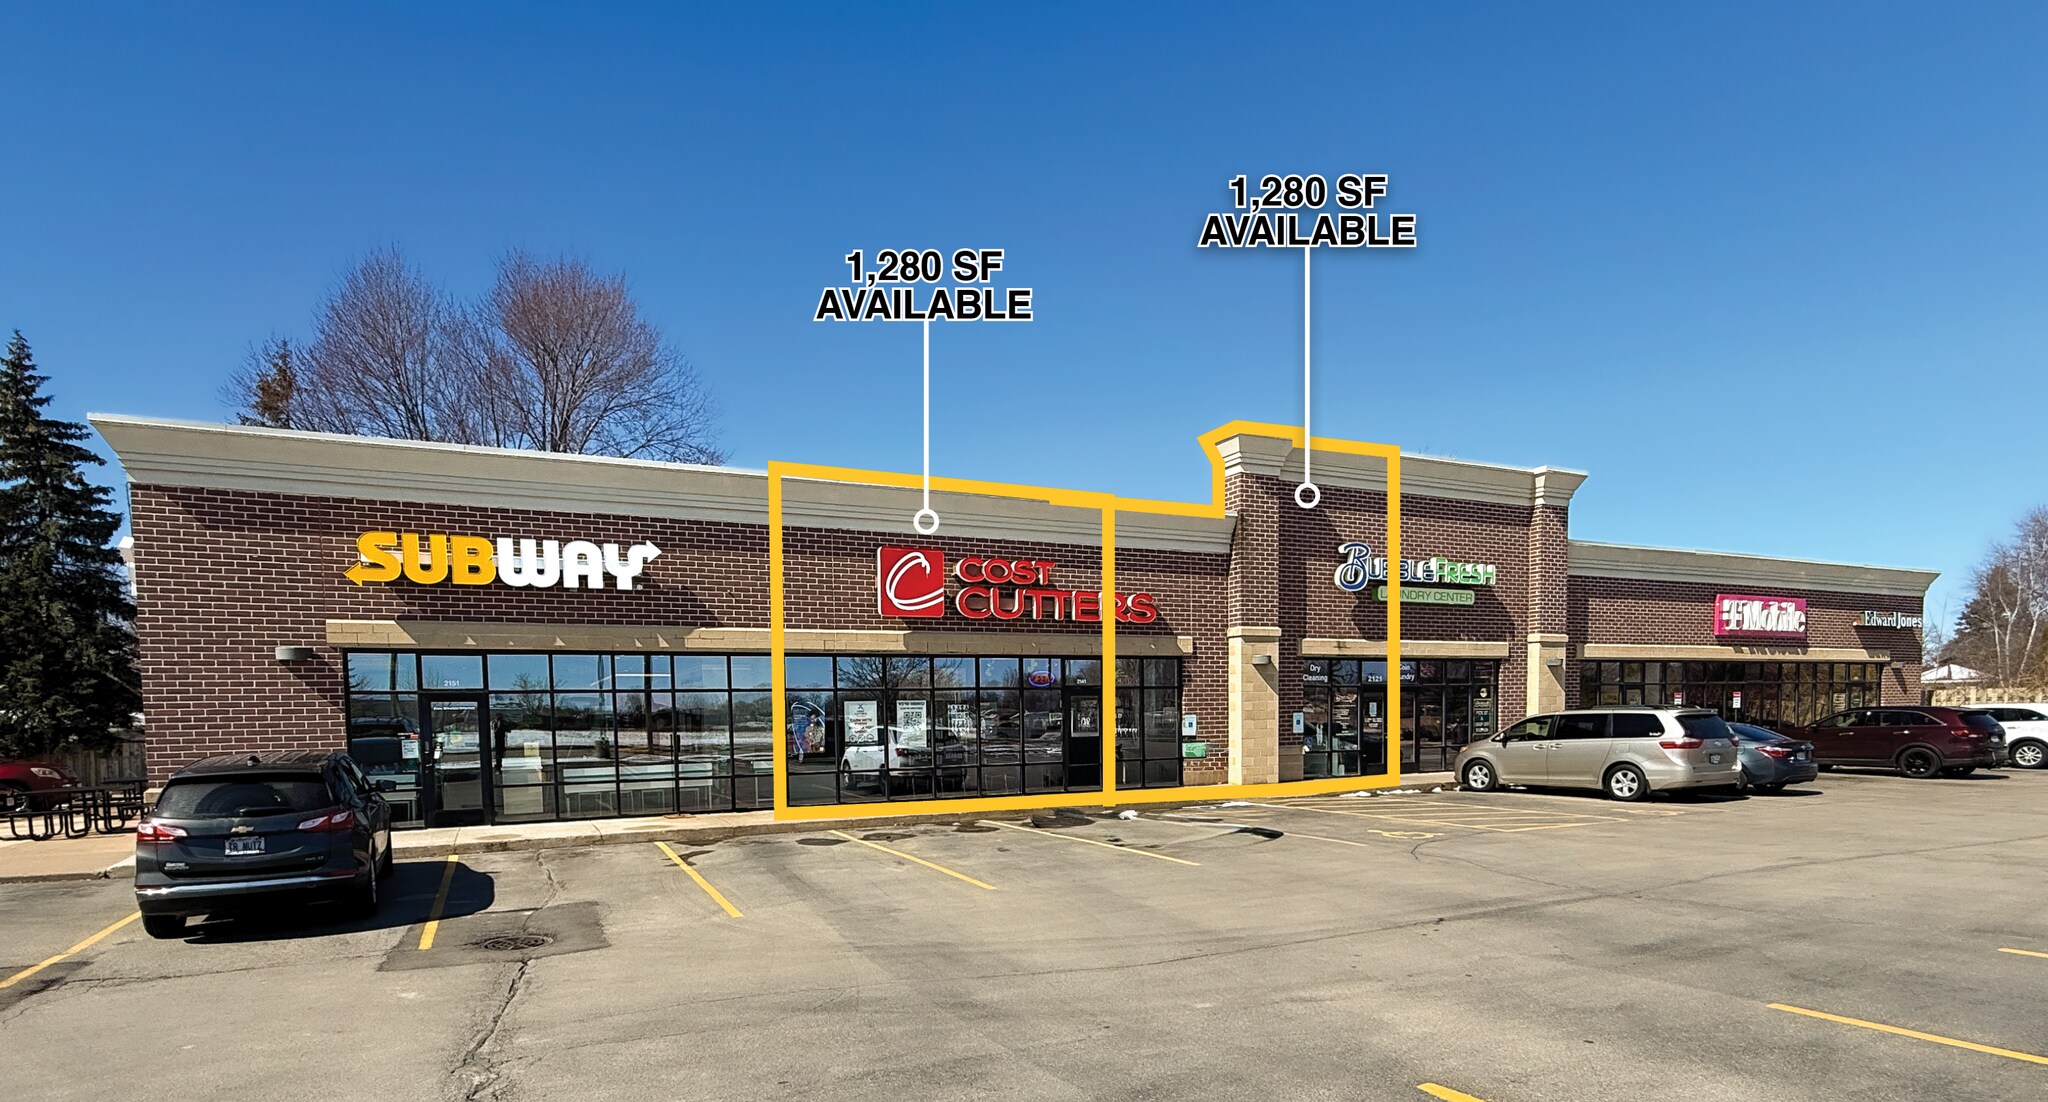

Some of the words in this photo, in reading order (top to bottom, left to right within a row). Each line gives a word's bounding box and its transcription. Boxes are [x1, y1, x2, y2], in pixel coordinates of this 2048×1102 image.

[343, 531, 662, 590] SUBWAY
[955, 557, 1055, 585] COST
[1380, 590, 1431, 601] LNDRY
[1434, 591, 1473, 602] CENTER
[955, 586, 1158, 623] CUTTERS
[1309, 664, 1321, 673] Dry
[1302, 674, 1328, 683] Cleaning
[1367, 675, 1383, 683] 2121
[1400, 673, 1415, 682] undry
[443, 679, 460, 687] 2151
